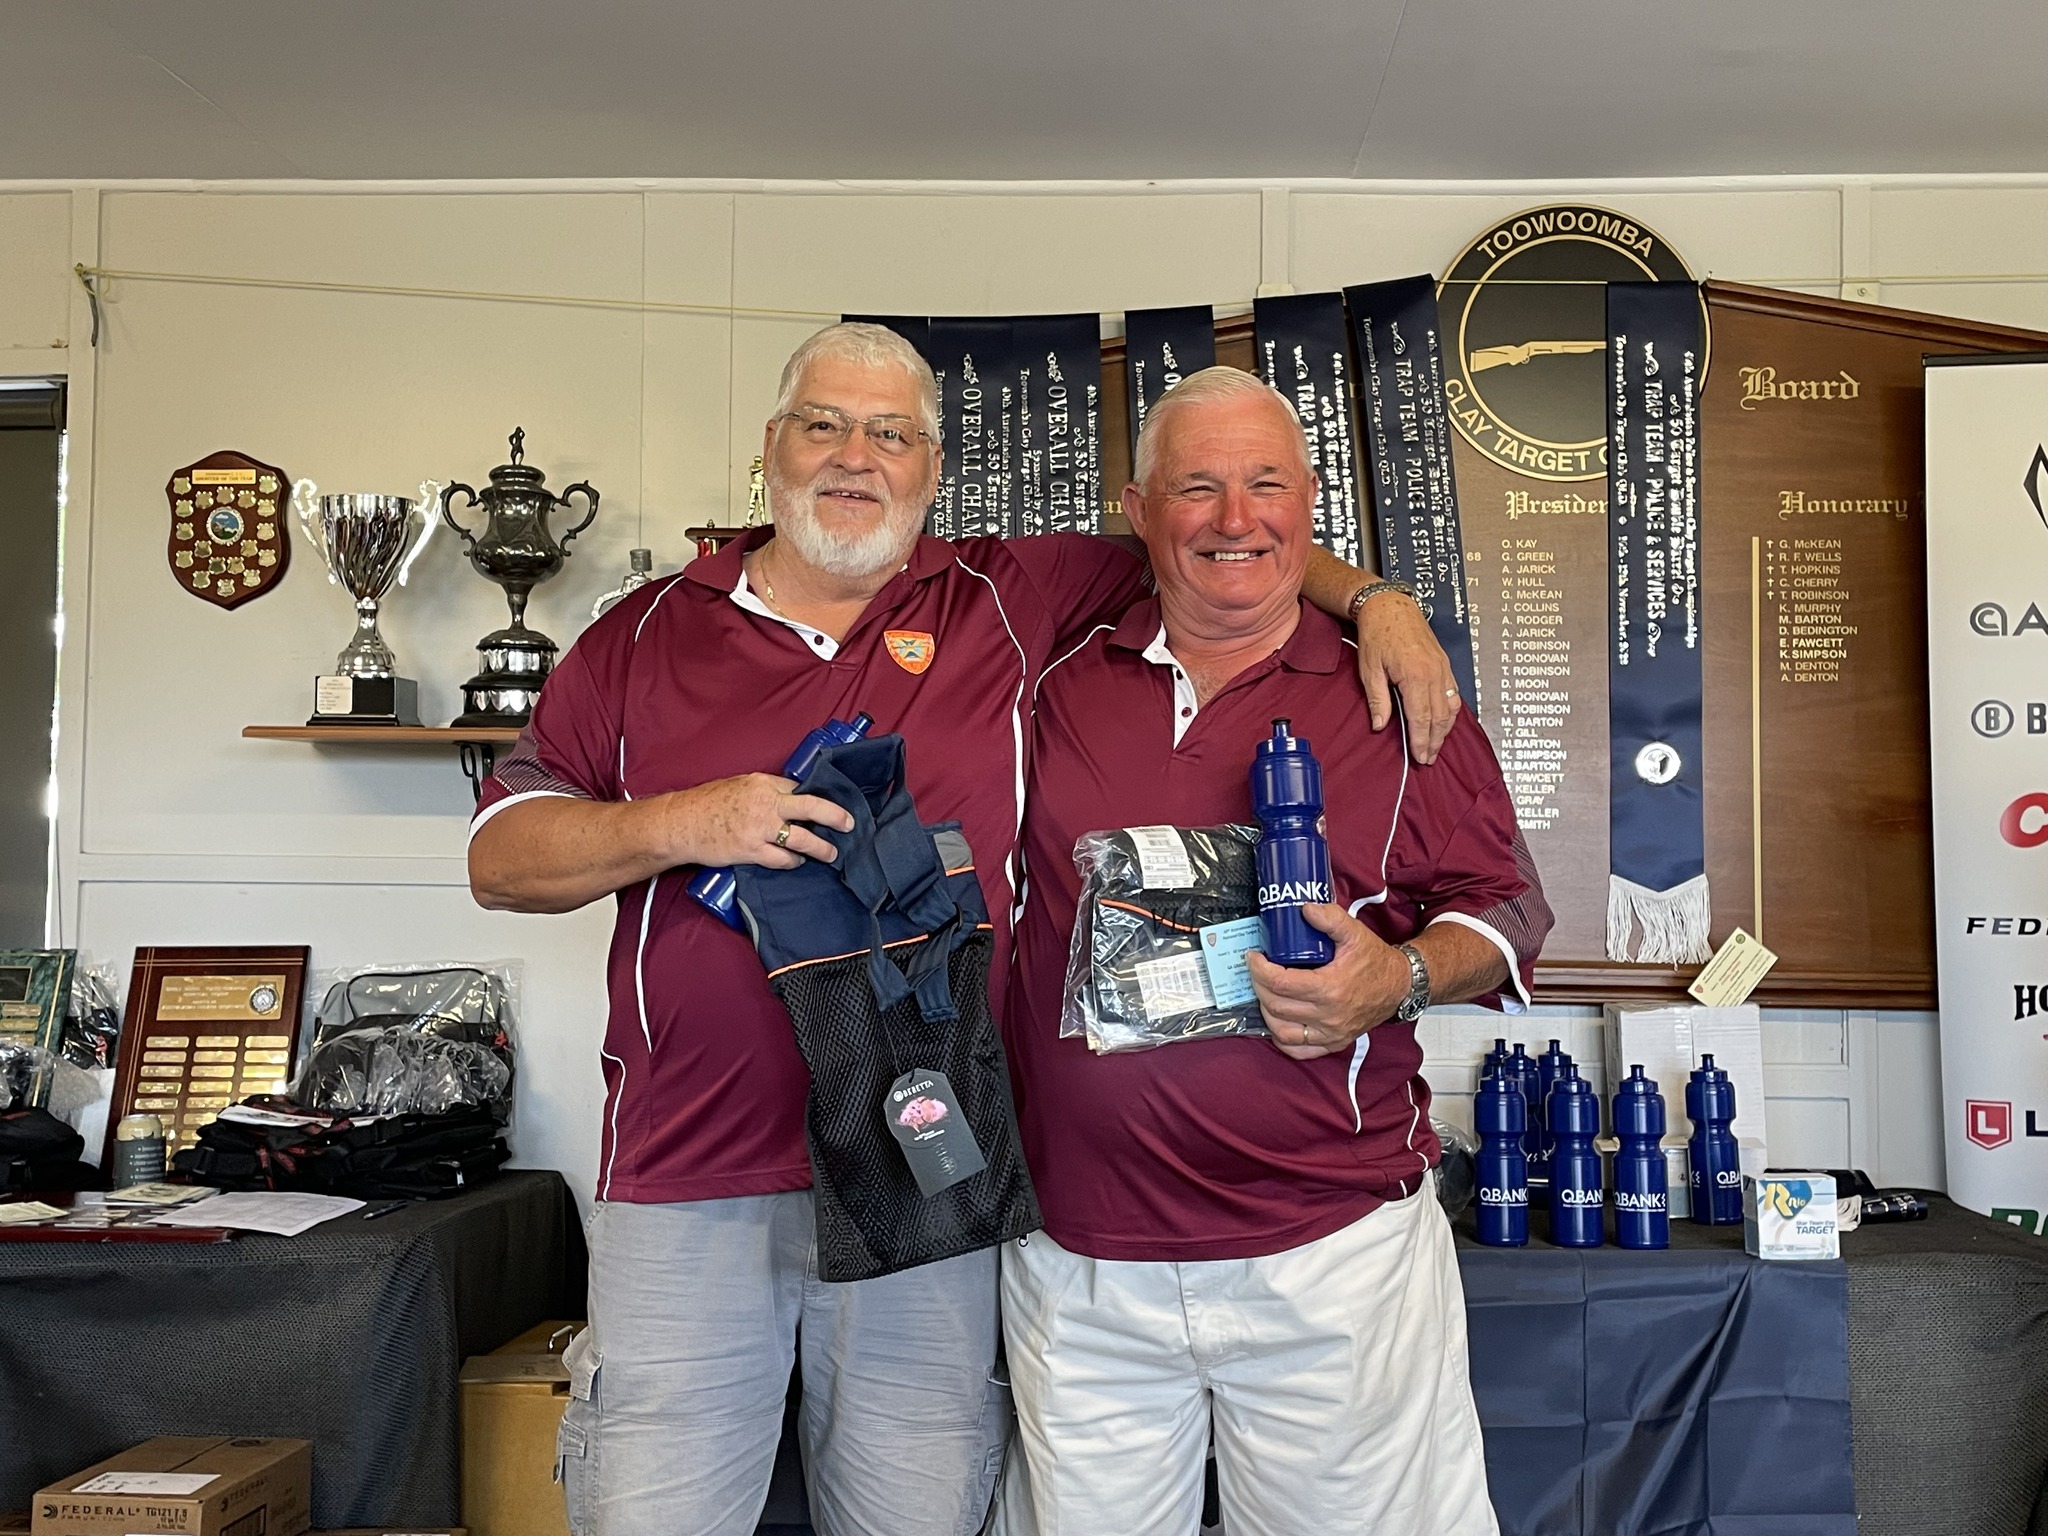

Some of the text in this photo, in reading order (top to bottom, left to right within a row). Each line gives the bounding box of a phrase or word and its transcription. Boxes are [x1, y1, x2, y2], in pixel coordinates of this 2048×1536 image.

[1477, 211, 1654, 259] TOOWOOMBA
[1371, 376, 1381, 397] Clay
[1739, 366, 1861, 410] Board
[1297, 382, 1316, 421] TRAP
[1445, 379, 1492, 436] CLAY
[1492, 432, 1590, 471] TARGET
[1670, 418, 1683, 436] 50
[962, 388, 982, 476] OVERALL
[1048, 386, 1069, 474] OVERALL
[1021, 428, 1032, 448] Clay
[988, 454, 1000, 470] 50
[1075, 451, 1088, 468] 50
[1396, 359, 1436, 598] TRAP TEAM POLICE & SERVICES
[1441, 454, 1450, 494] Services
[1645, 380, 1666, 620] TRAP TEAM POLICE & SERVICES
[1444, 497, 1454, 517] Clay
[1778, 491, 1908, 520] Honorary
[1445, 518, 1457, 551] Target
[1502, 540, 1537, 548] O. KAY
[1779, 540, 1841, 549] G. McKEAN
[1502, 552, 1553, 561] G. GREEN
[1779, 552, 1790, 561] R.
[1805, 552, 1842, 561] WELLS
[1502, 565, 1556, 574] A. JARICK
[1780, 565, 1840, 574] T. HOPKINS
[1502, 578, 1545, 587] W. HULL
[1779, 578, 1838, 587] C. CHERRY
[1450, 553, 1465, 624] Championships
[1502, 590, 1562, 599] G. McKEAN
[1780, 591, 1849, 600] T. ROBINSON
[1502, 603, 1559, 612] J. COLLINS
[1779, 604, 1841, 612] K. MURPHY
[1502, 616, 1563, 625] A. RODGER
[1779, 615, 1842, 624] M. BARTON
[1502, 628, 1556, 637] A. JARICK
[1779, 626, 1858, 635] D. BEDINGTON
[1502, 641, 1570, 650] T. ROBINSON
[1779, 638, 1843, 647] E. FAWCETT
[1502, 654, 1569, 663] R. DONOVAN
[1502, 667, 1570, 675] T. ROBINSON
[1780, 662, 1839, 671] M. DENTON
[1781, 673, 1838, 682] A. DENTON
[1502, 679, 1549, 688] D. MOON
[1502, 692, 1569, 701] R. DONOVAN
[1502, 705, 1570, 714] T. ROBINSON
[1502, 717, 1563, 727] M. BARTON
[1504, 728, 1538, 738] T. GILL
[1502, 750, 1567, 760] K. SIMPSON
[1516, 773, 1564, 782] FAWCETT
[1515, 784, 1555, 793] KELLER
[1517, 796, 1544, 805] GRAY
[1517, 808, 1559, 817] KELLER
[1517, 820, 1551, 829] SMITH
[903, 1080, 934, 1096] BERETTA
[1796, 1226, 1835, 1234] TARGET
